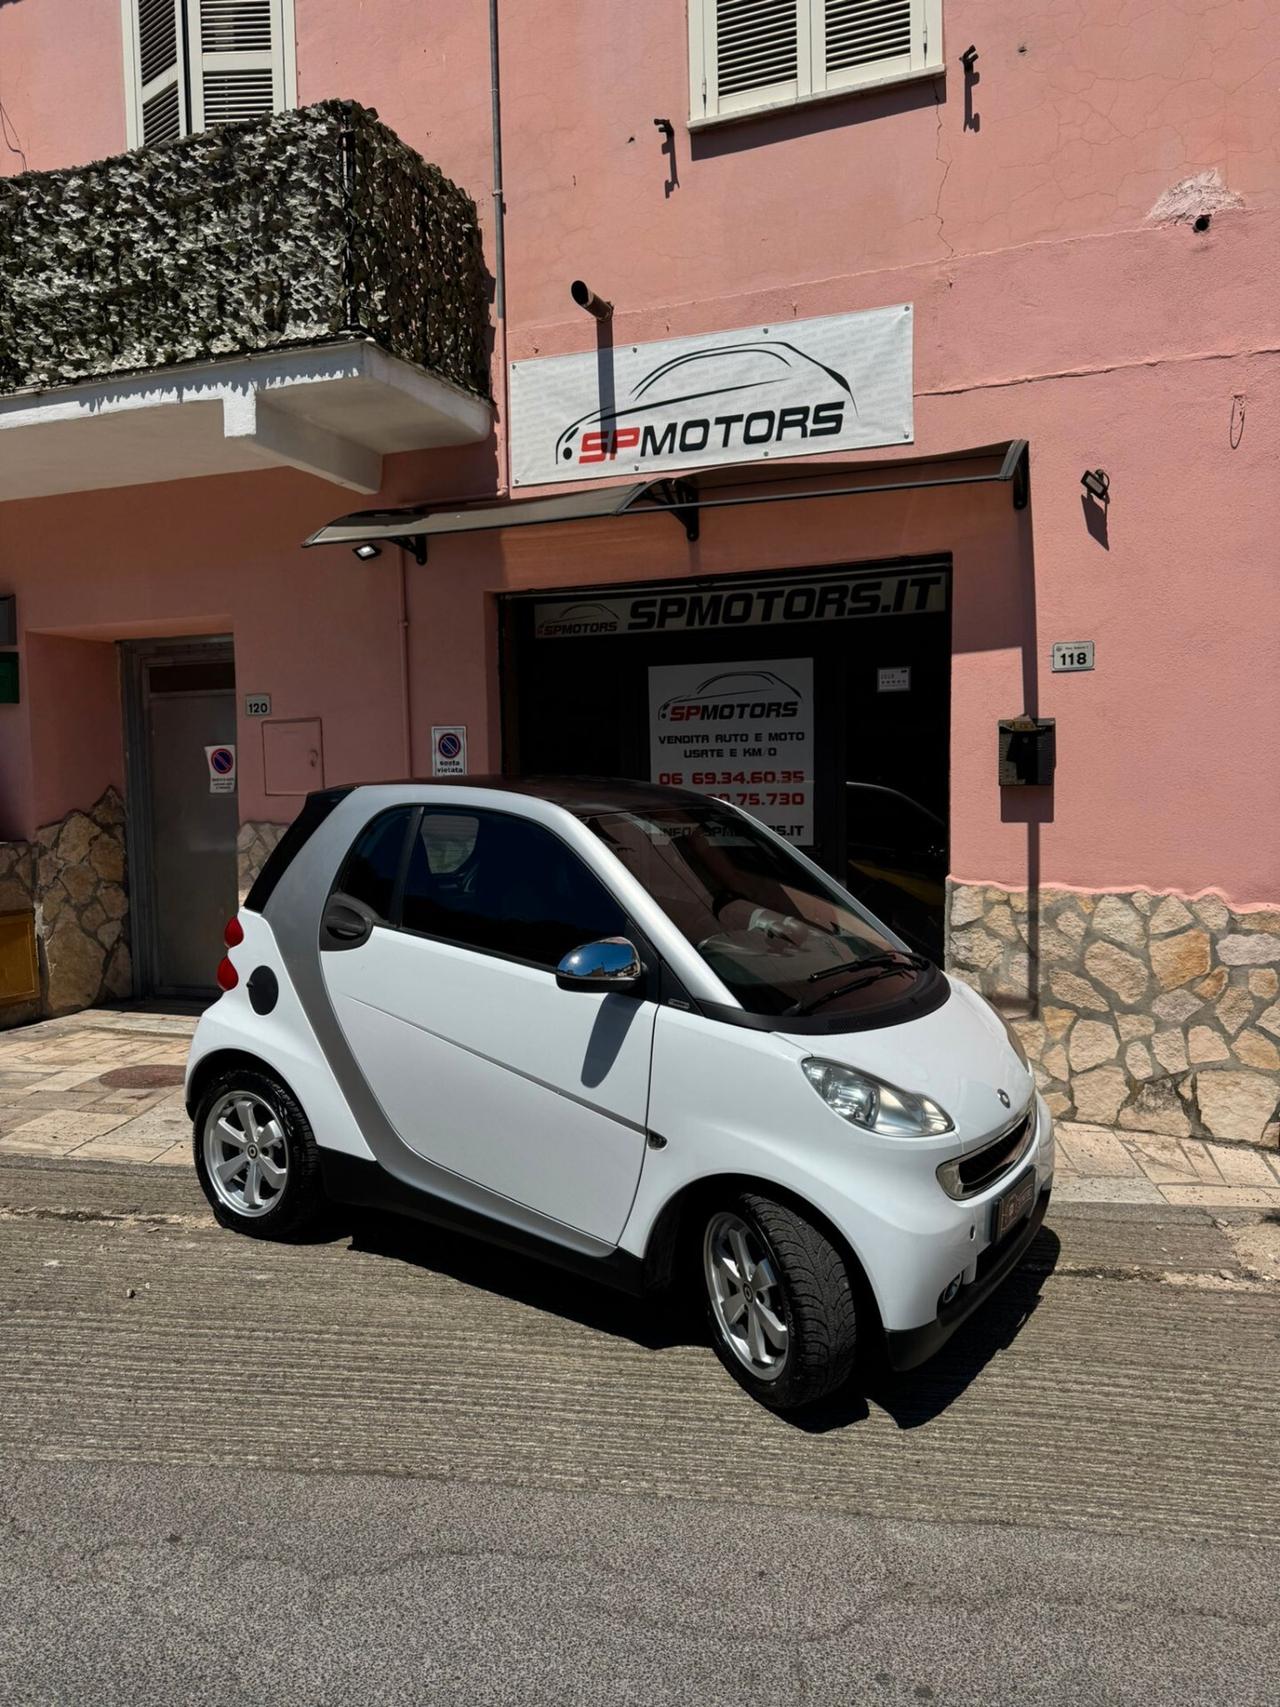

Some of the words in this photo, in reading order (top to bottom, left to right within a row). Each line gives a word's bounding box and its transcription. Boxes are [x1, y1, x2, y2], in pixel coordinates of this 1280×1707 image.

[578, 401, 845, 464] SPMOTORS
[628, 576, 942, 631] SPMOTORS.IT
[543, 621, 617, 636] SPMOTORS
[1060, 652, 1087, 666] 118
[248, 702, 268, 713] 120
[670, 701, 798, 722] SPMOTORS
[658, 734, 710, 745] VENDITA
[715, 733, 749, 743] AUTO
[755, 732, 763, 742] E
[768, 731, 805, 742] MOTO
[684, 748, 724, 759] USATE
[729, 748, 737, 757] E
[743, 748, 762, 757] KM
[659, 772, 684, 785] 06
[692, 770, 805, 785] 69.34.60.35
